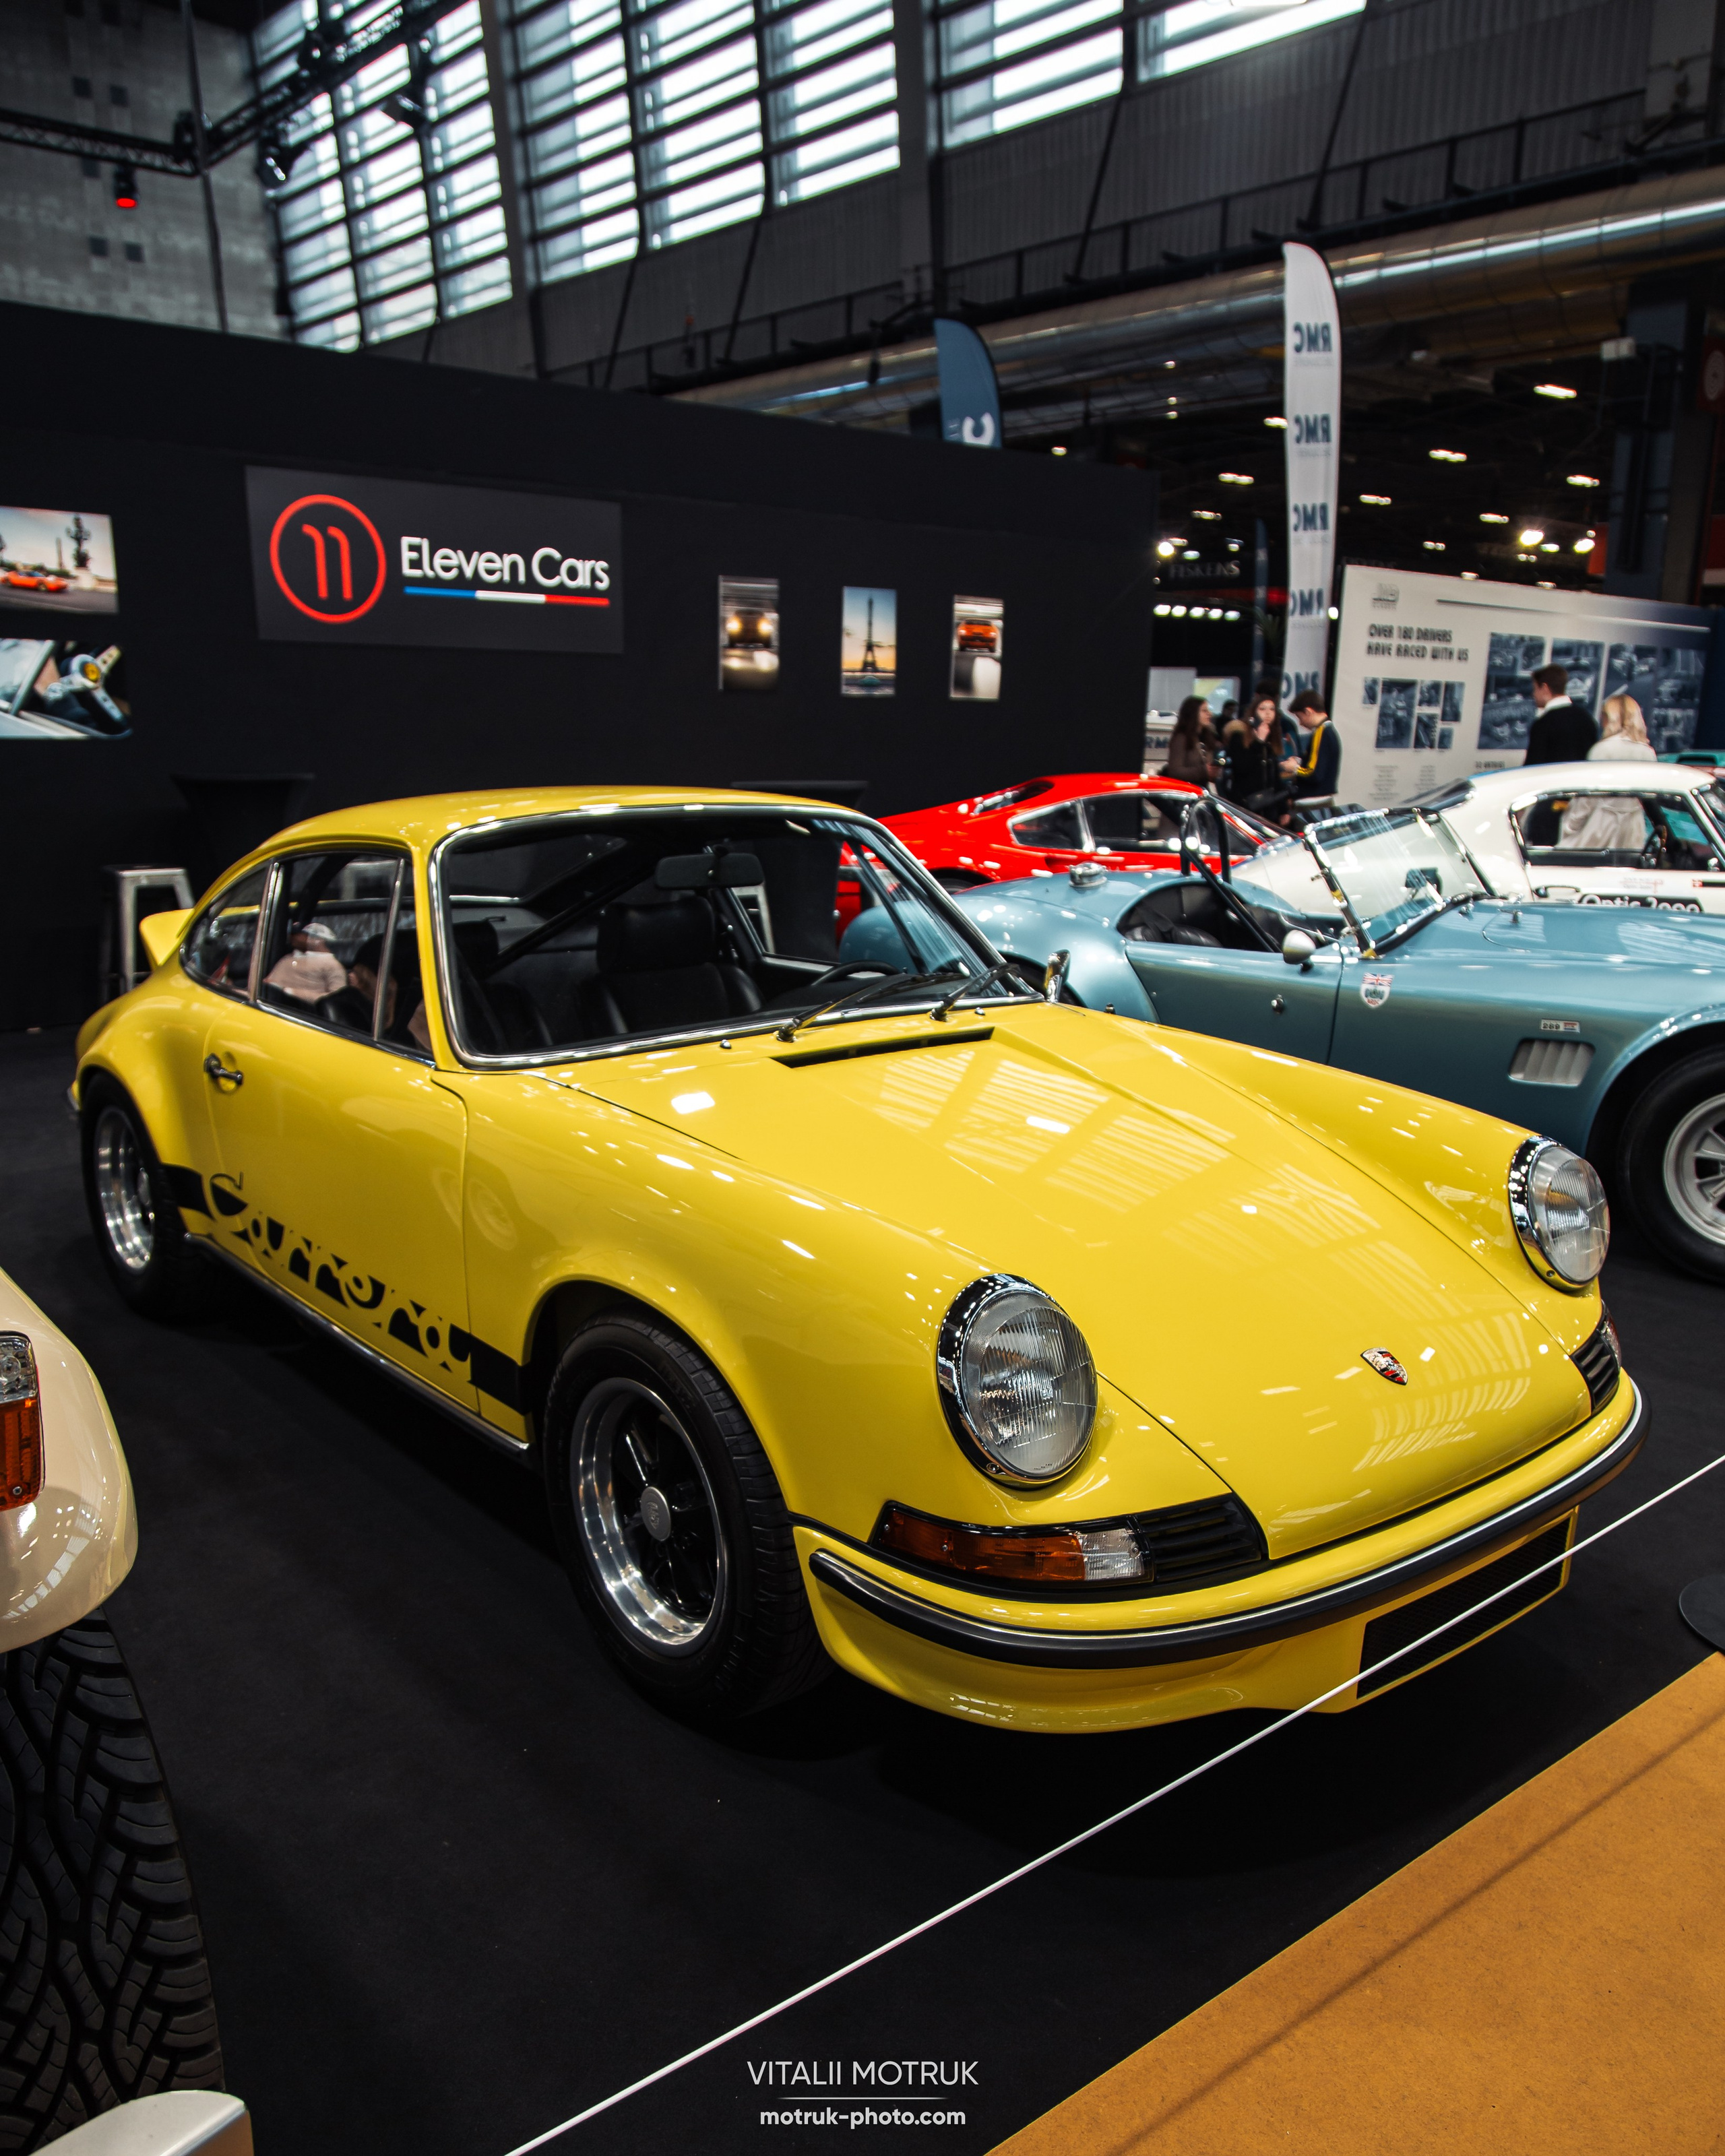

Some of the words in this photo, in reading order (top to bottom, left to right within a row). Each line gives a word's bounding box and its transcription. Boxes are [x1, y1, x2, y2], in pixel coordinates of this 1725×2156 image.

[400, 536, 526, 584] Eleven
[531, 547, 610, 590] Cars
[1367, 641, 1393, 656] HAVE
[1396, 643, 1428, 659] RACED
[1431, 646, 1455, 661] WITH
[1457, 648, 1470, 662] US
[1368, 623, 1394, 639] OVER
[1416, 627, 1453, 643] DRIVERS
[202, 1171, 473, 1385] Carrera
